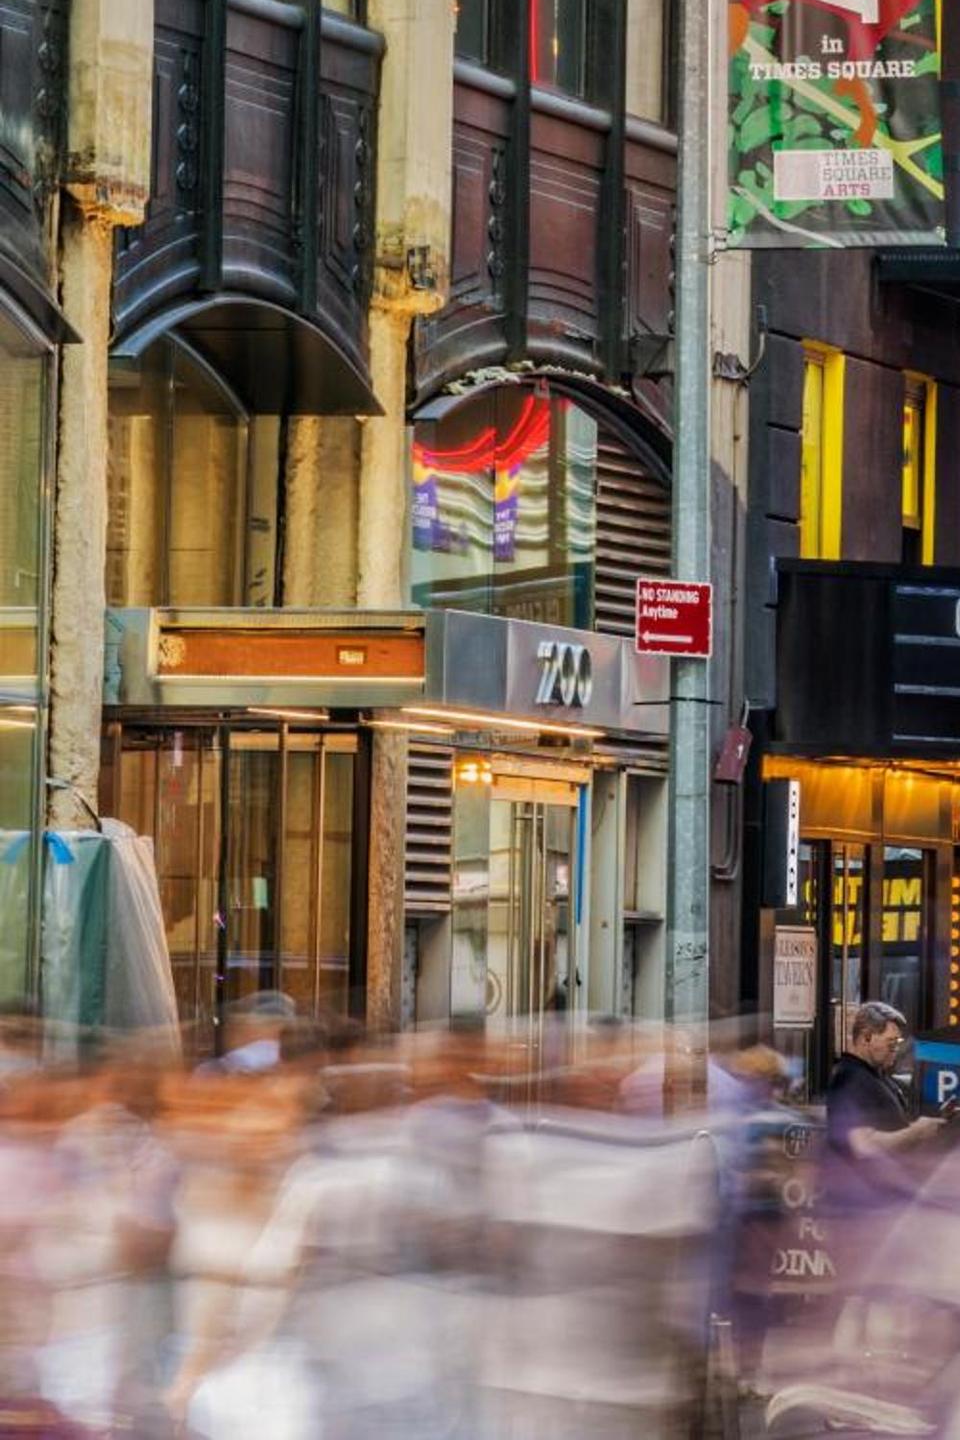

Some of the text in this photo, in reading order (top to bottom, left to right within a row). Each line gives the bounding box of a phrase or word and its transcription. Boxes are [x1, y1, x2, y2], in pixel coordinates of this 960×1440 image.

[821, 35, 845, 54] in
[749, 60, 916, 81] TIMES SQUARE
[822, 151, 880, 166] TIMES
[822, 167, 892, 182] SQUARE
[822, 183, 871, 197] ARTS
[642, 587, 700, 605] NO STANDING
[642, 605, 679, 621] Anytime
[536, 641, 592, 706] 700
[938, 1070, 959, 1102] P
